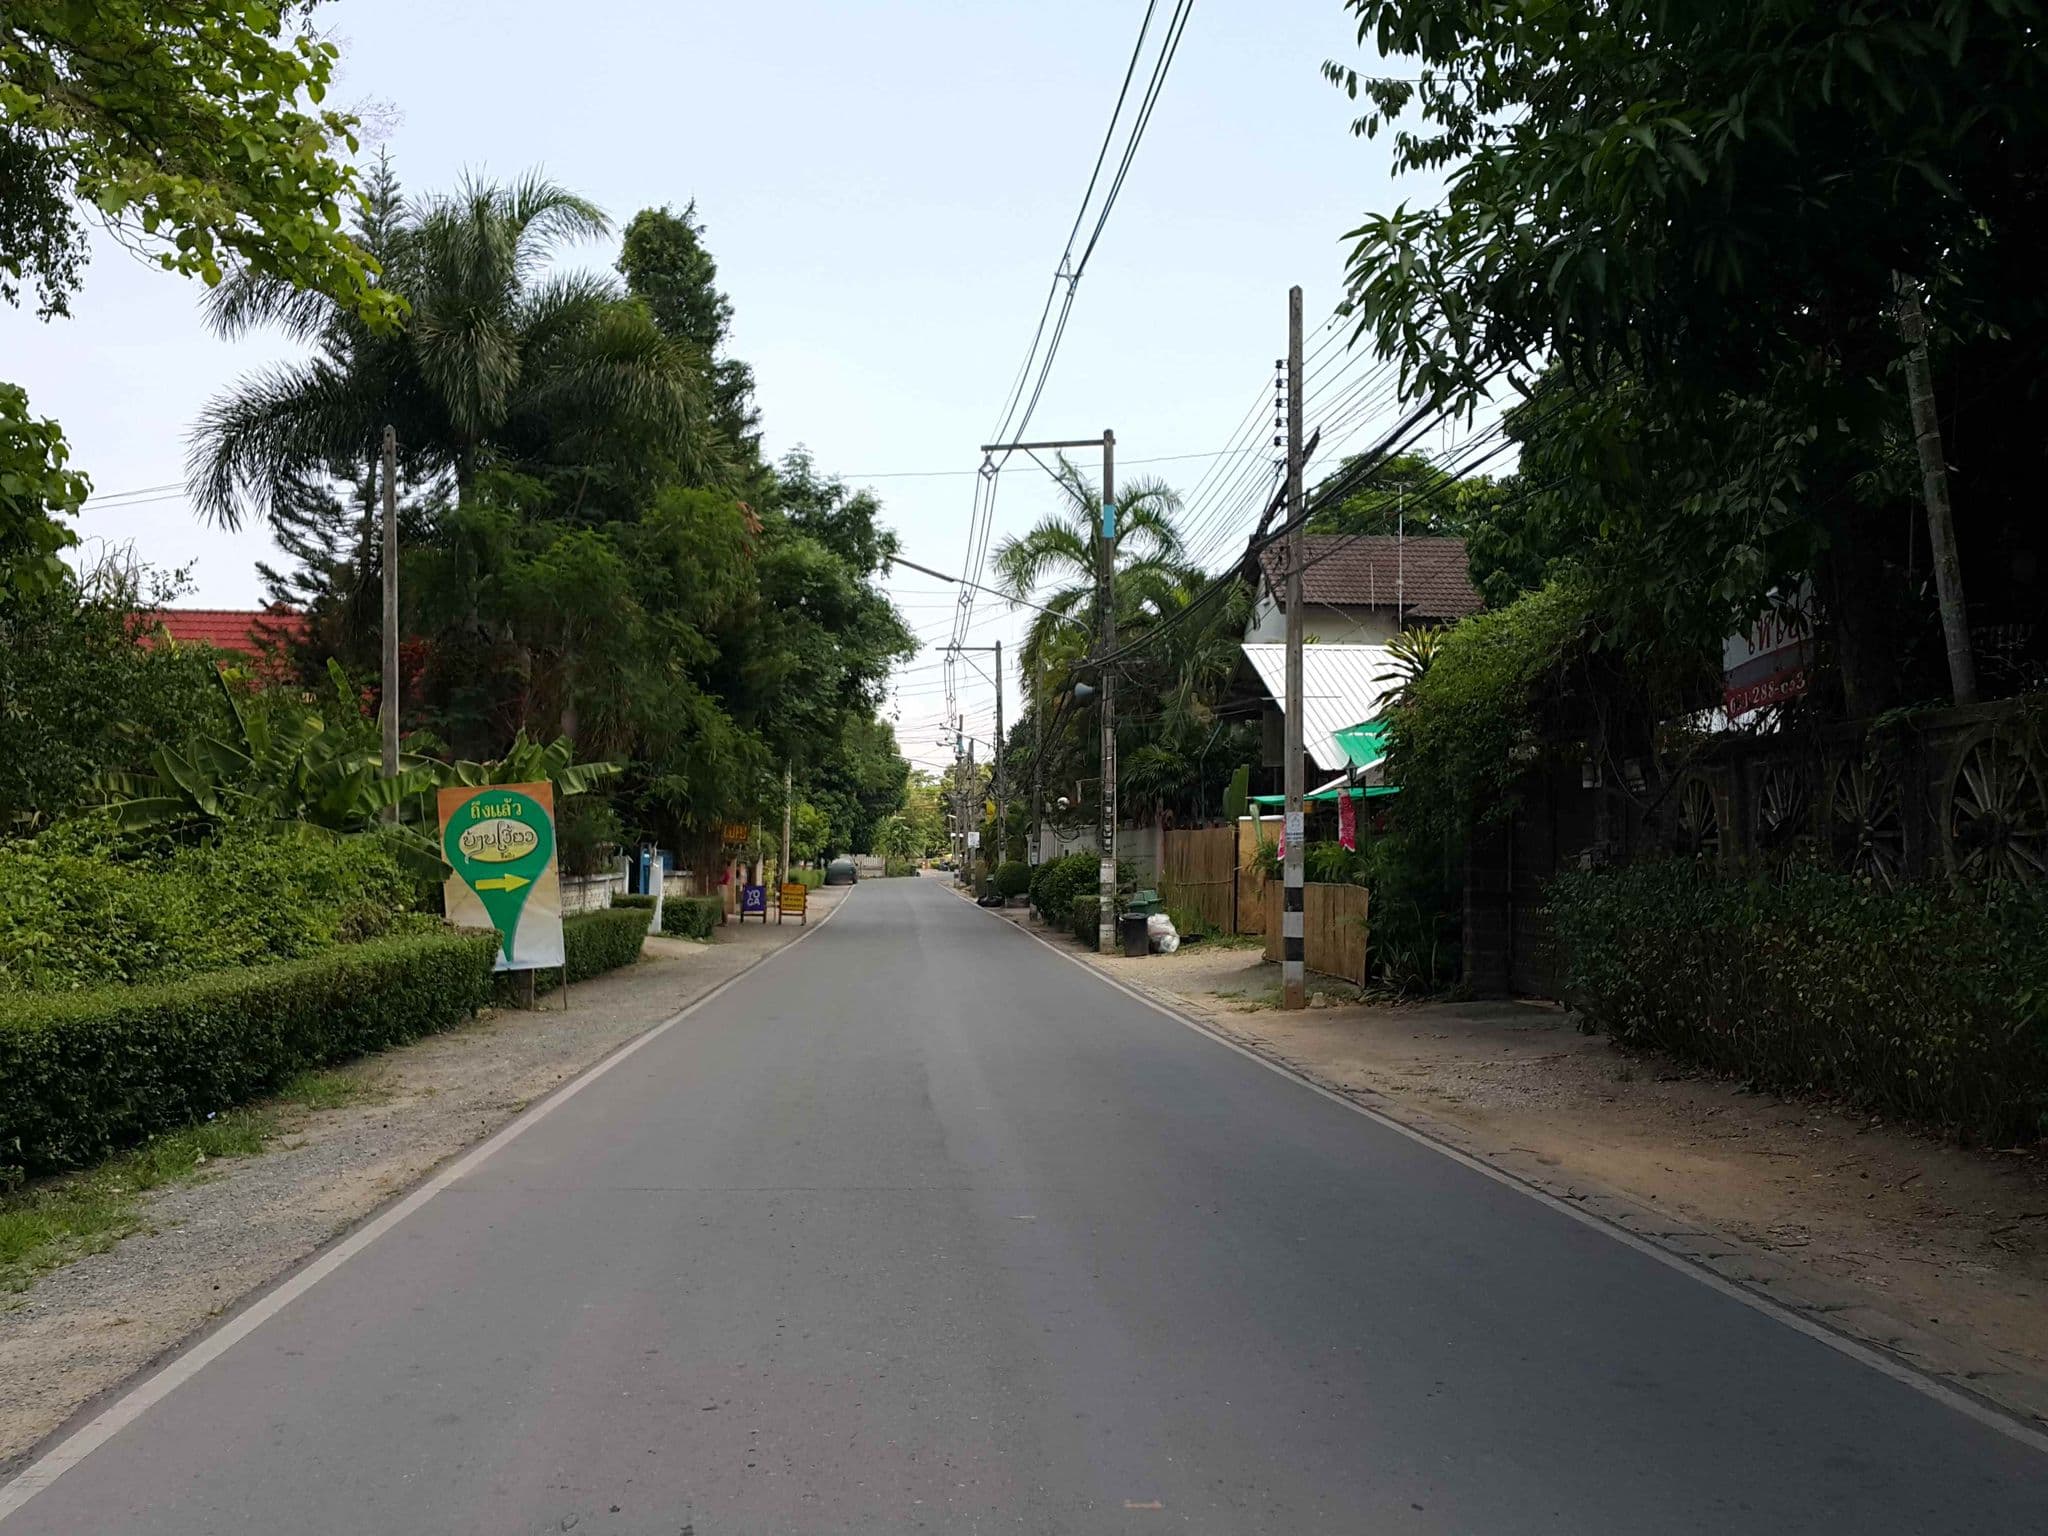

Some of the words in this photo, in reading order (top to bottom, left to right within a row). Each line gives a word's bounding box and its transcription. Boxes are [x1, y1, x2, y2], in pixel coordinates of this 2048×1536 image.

[470, 798, 522, 819] ถึงแล้ว
[746, 889, 761, 898] YO
